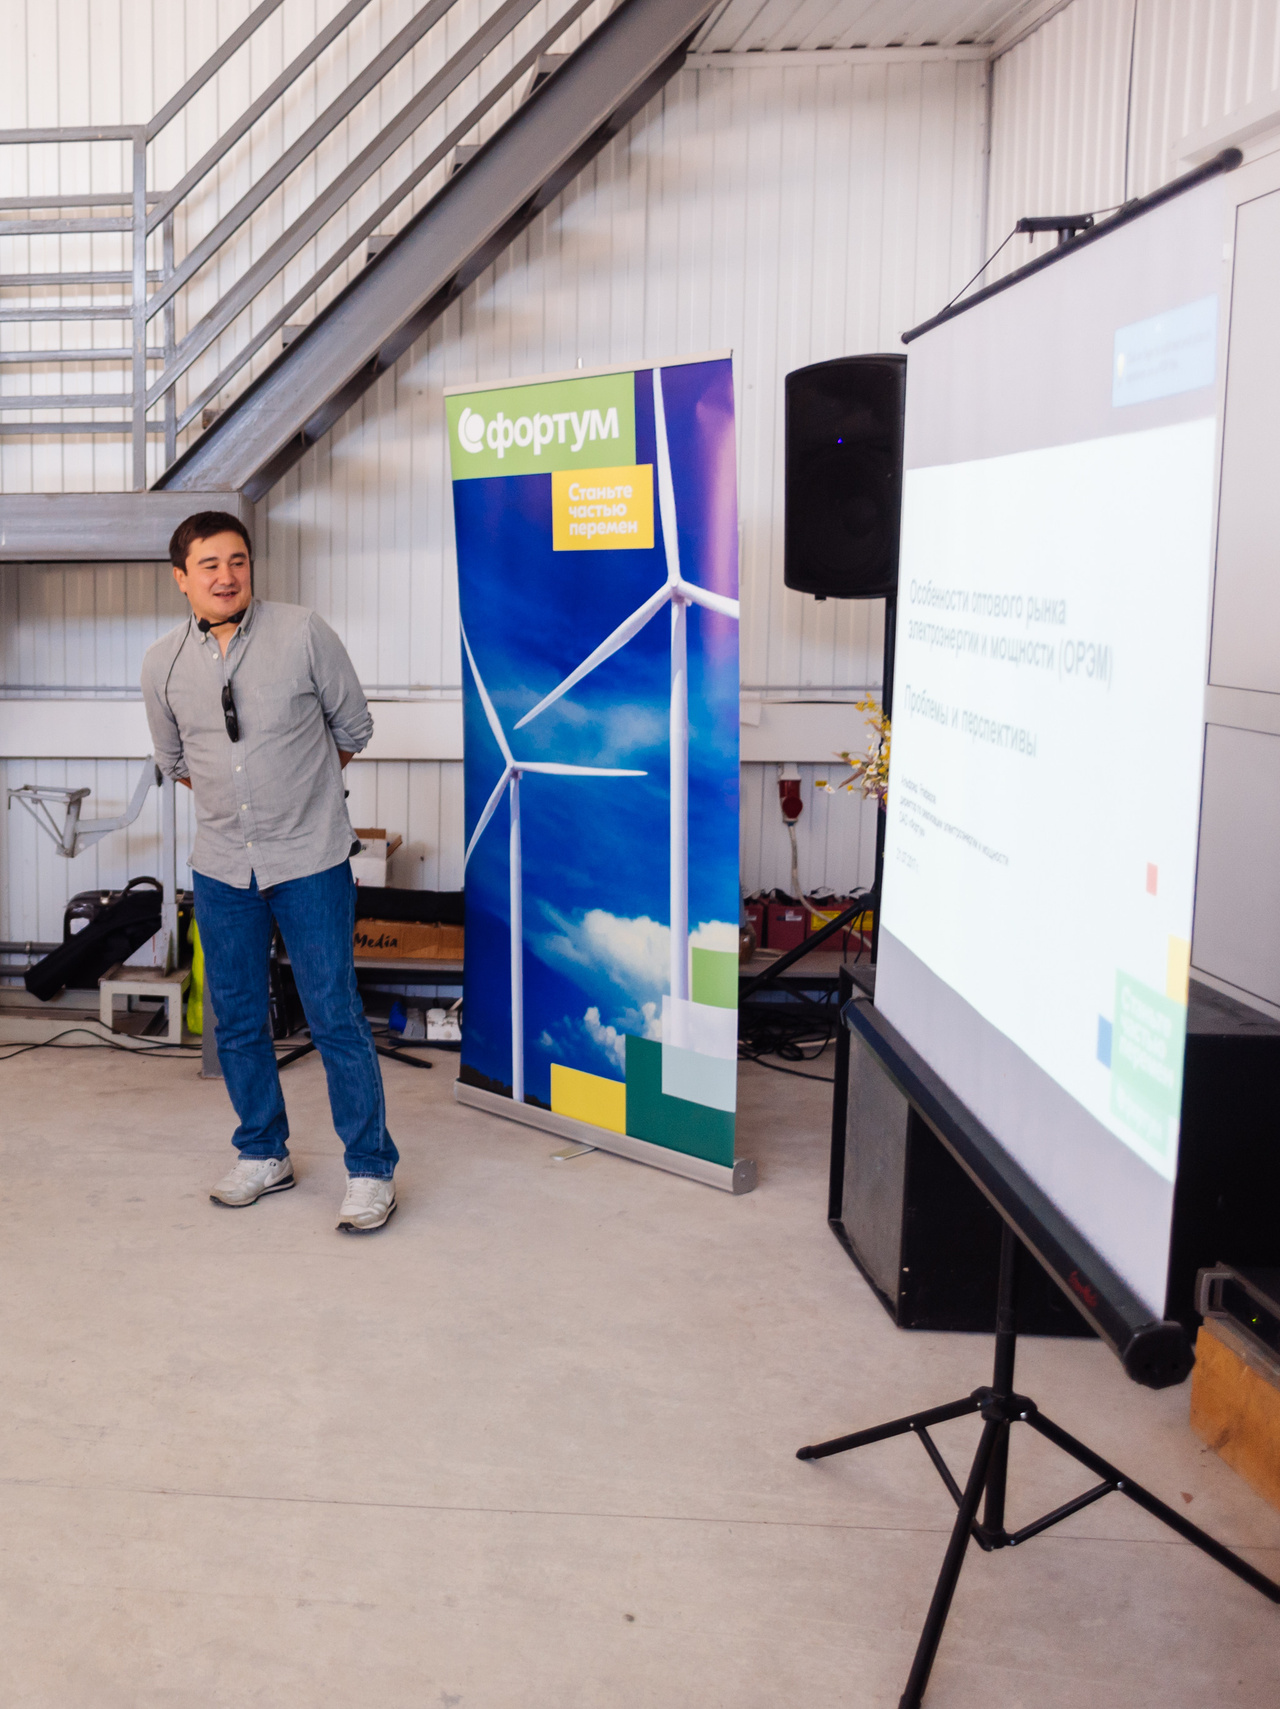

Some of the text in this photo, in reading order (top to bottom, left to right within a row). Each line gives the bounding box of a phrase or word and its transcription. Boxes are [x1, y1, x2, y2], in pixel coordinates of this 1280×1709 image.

[486, 407, 619, 459] фортум
[568, 482, 633, 502] Станьте
[568, 503, 627, 519] частью
[569, 520, 638, 540] перемен
[910, 578, 1066, 630] Особенности оптового рынка
[908, 619, 1114, 693] электроэнергии и мощности (ОРЭМ)
[904, 683, 1038, 758] Проблемы и перспективы
[354, 932, 398, 949] Media
